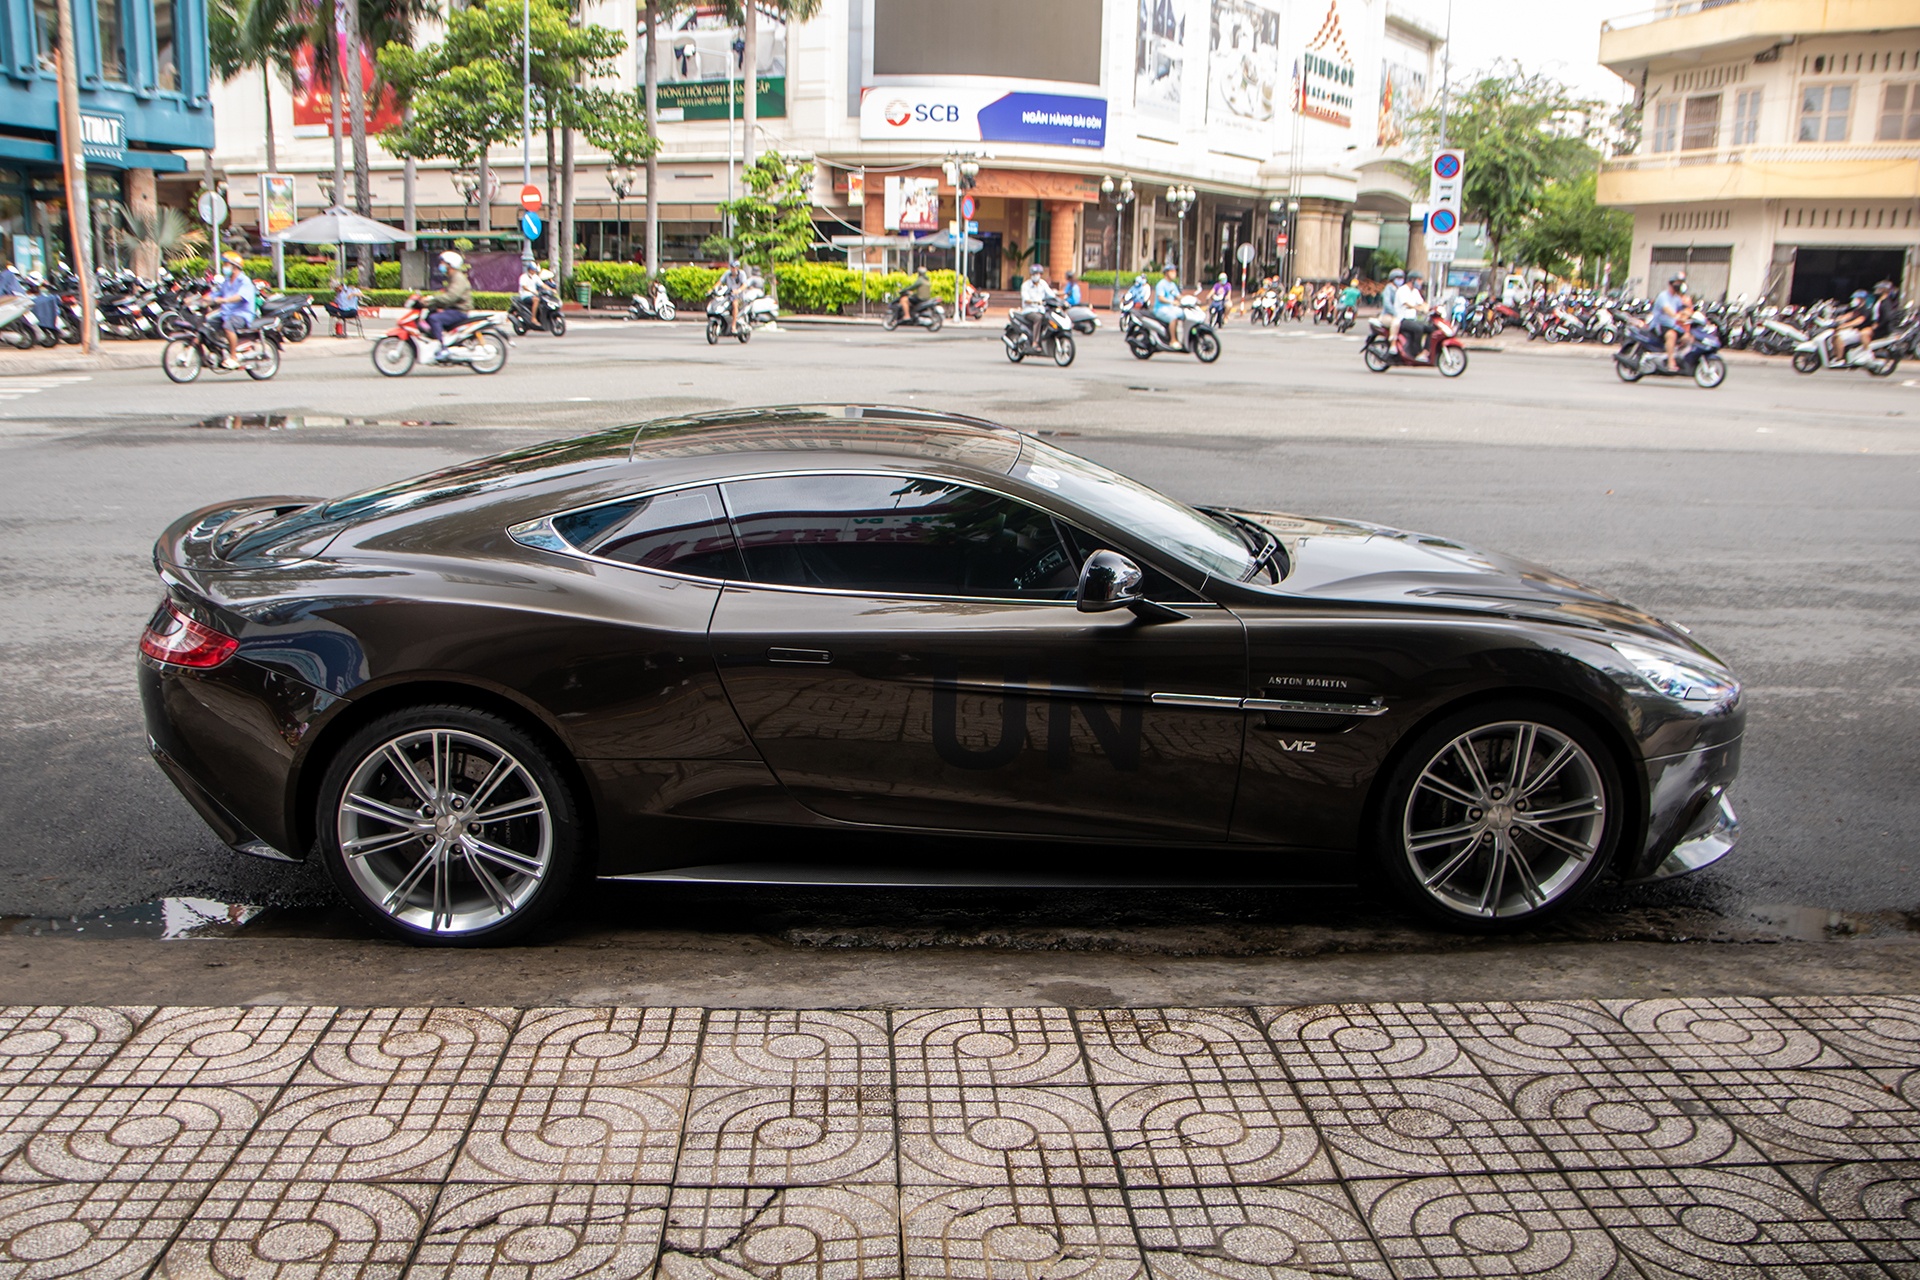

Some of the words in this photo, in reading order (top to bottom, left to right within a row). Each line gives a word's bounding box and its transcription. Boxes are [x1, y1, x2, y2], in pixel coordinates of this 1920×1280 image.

[915, 104, 960, 123] SCB
[1022, 110, 1049, 125] NGÂN
[1049, 111, 1073, 127] HÀNG
[1268, 675, 1303, 686] ASTON
[1305, 678, 1348, 689] MARTIN
[1278, 739, 1316, 752] V12
